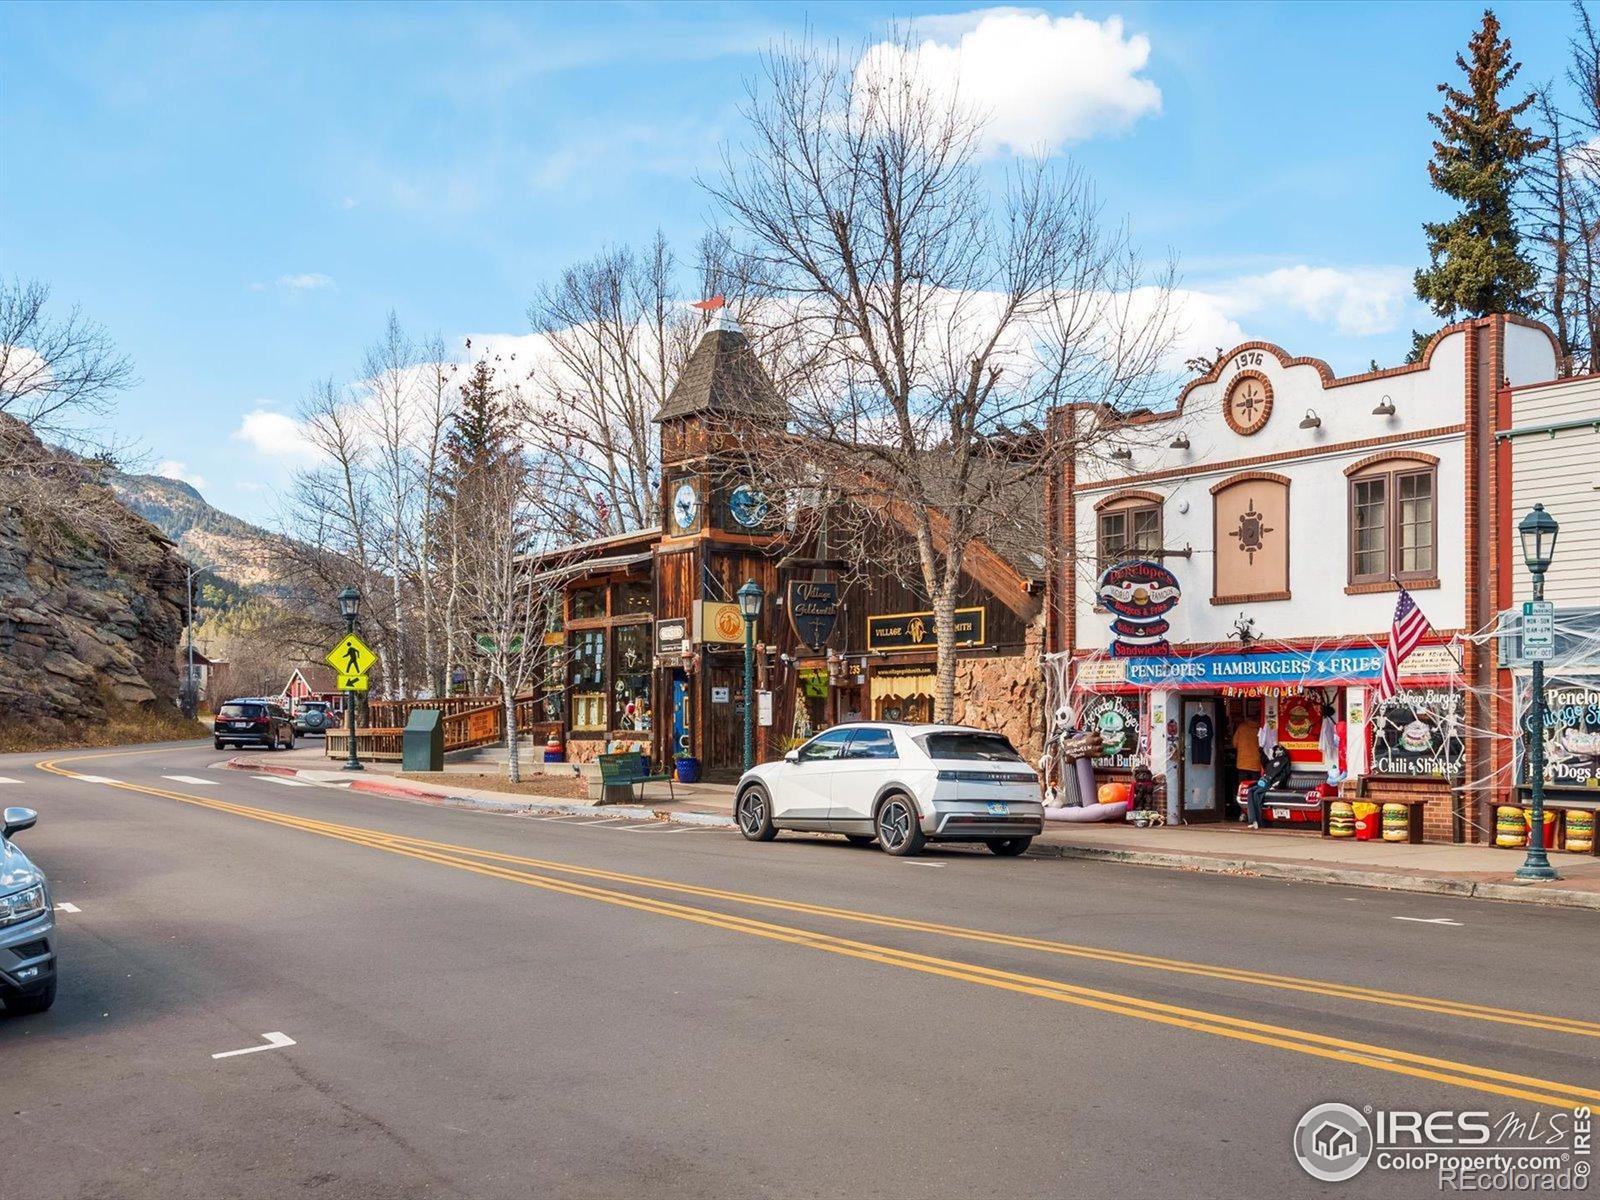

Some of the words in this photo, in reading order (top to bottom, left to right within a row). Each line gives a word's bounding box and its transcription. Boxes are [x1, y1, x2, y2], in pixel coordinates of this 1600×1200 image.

[1234, 352, 1264, 370] 1976
[796, 583, 831, 602] Village
[1114, 601, 1141, 616] Burgers
[875, 628, 902, 637] VILLAGE
[1130, 662, 1207, 678] PENELOPE'S
[1212, 659, 1312, 676] HAMBURGERS
[1317, 661, 1327, 673] &
[1330, 657, 1381, 674] FRIES
[1221, 685, 1249, 698] HAPPY
[1424, 689, 1460, 710] Burger
[1547, 688, 1600, 708] Penelo
[1526, 704, 1583, 733] Cicago
[1099, 754, 1114, 767] and
[1379, 757, 1407, 773] Chili
[1417, 757, 1460, 774] Shakes
[1557, 763, 1591, 783] Dogs
